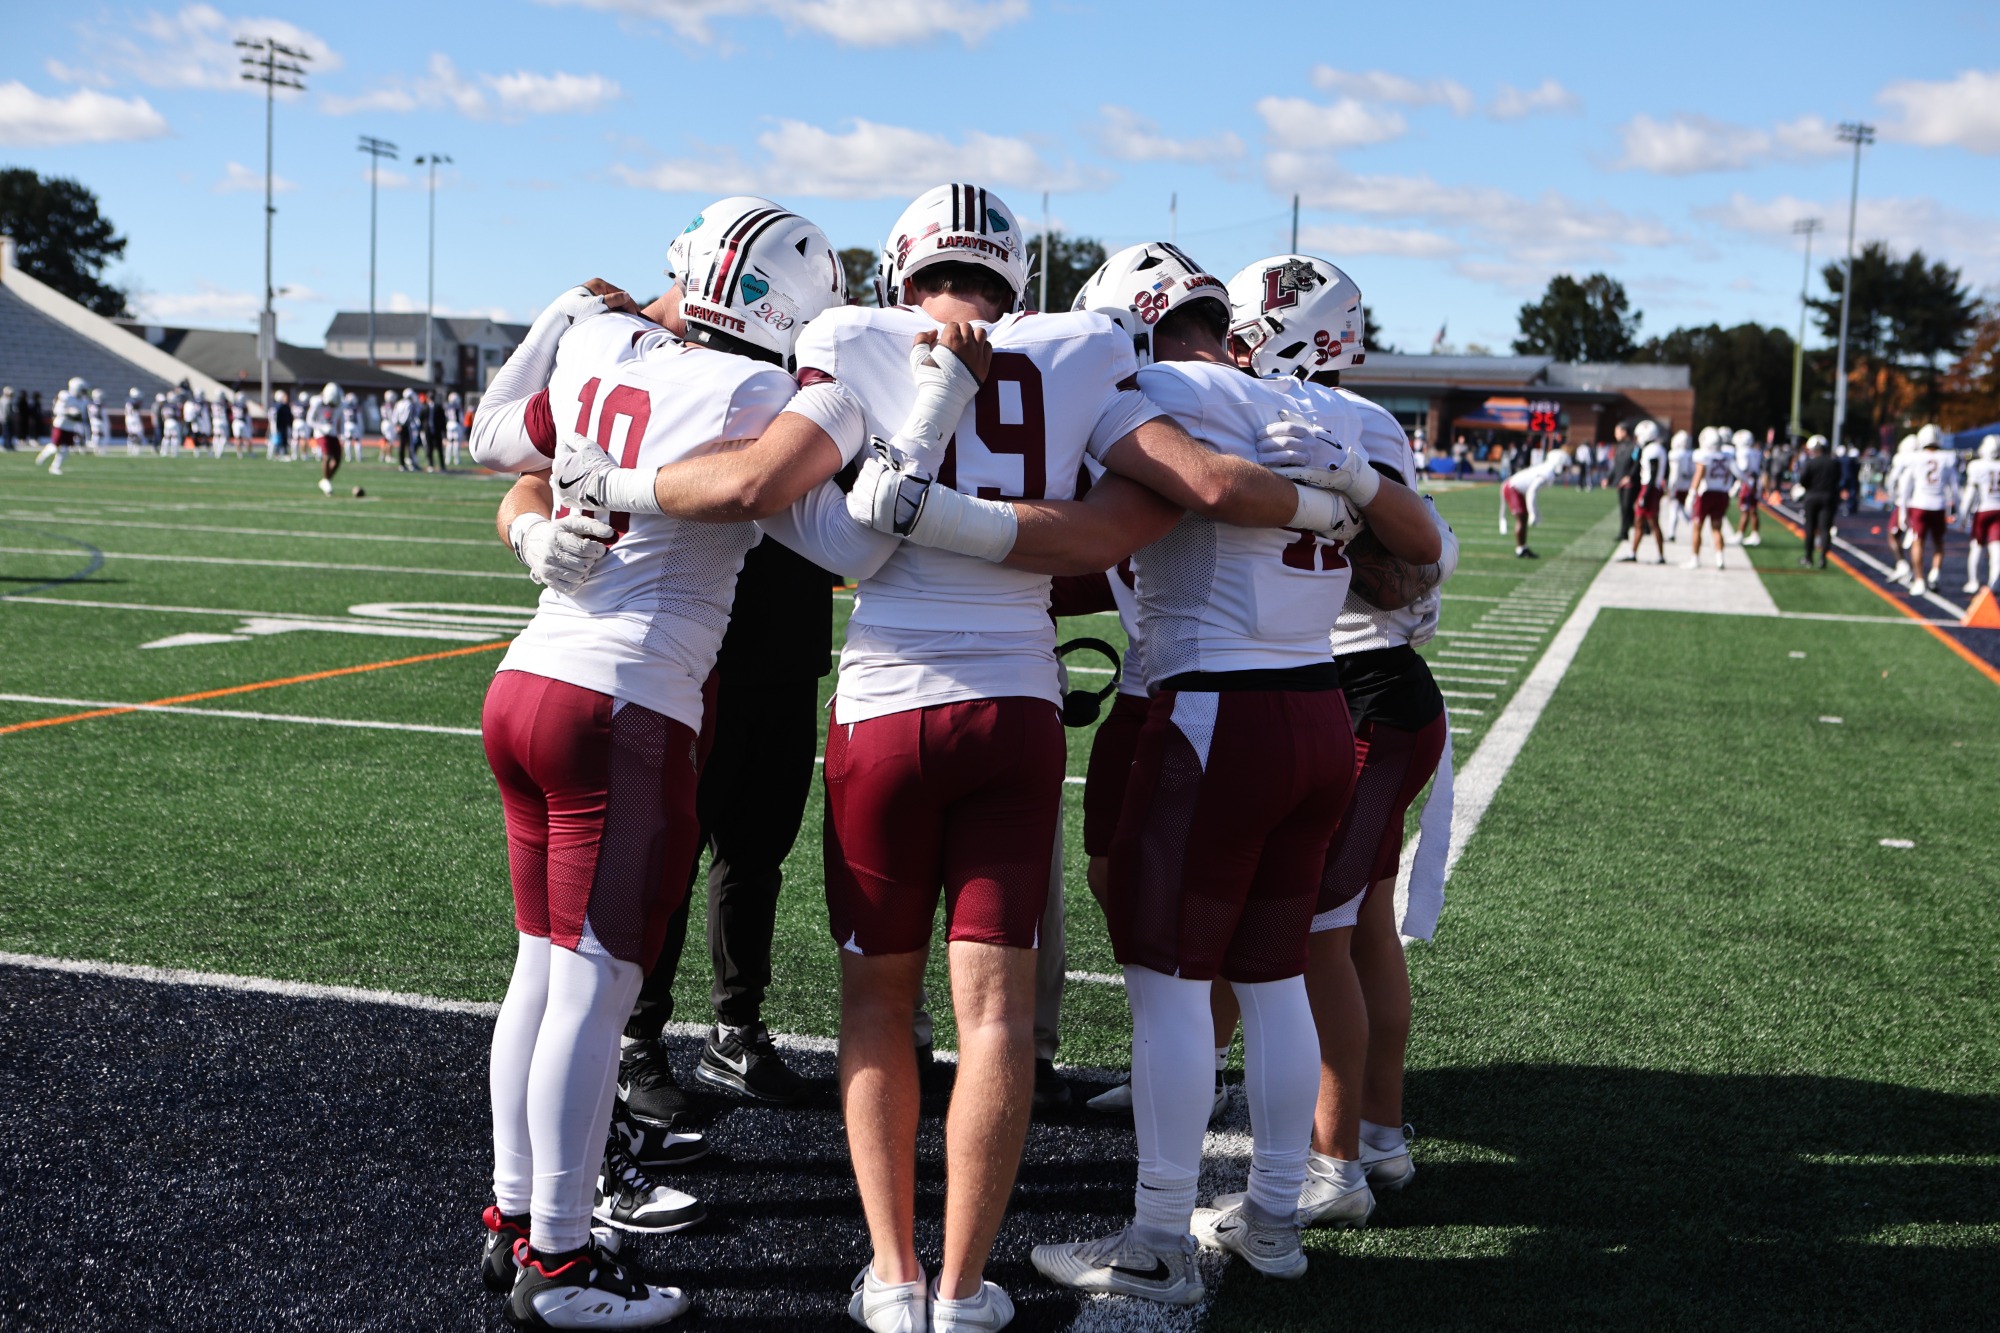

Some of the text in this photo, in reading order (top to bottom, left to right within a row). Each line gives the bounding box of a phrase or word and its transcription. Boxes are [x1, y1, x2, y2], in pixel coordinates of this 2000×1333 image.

[937, 235, 1009, 263] LAFAYETTE
[743, 282, 764, 295] LAUREN
[684, 303, 747, 334] LAFAYETTE
[1530, 410, 1557, 433] 25
[1926, 460, 1939, 485] 2
